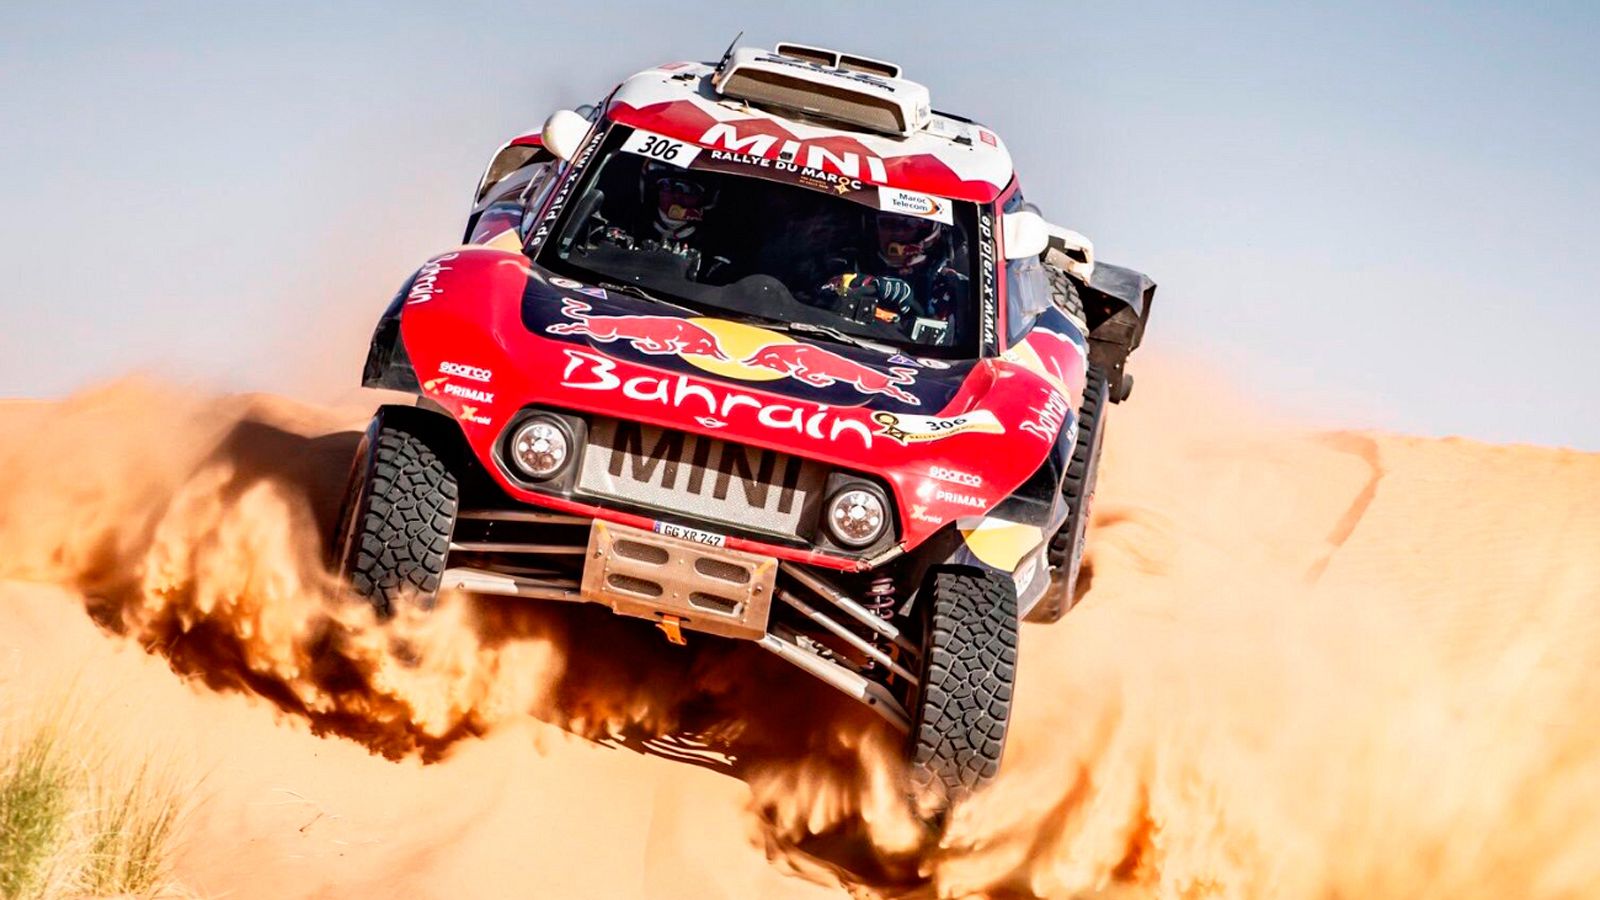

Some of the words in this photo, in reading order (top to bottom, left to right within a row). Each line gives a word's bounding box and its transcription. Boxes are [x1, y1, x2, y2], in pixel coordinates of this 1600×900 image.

[637, 135, 683, 161] 306
[699, 122, 888, 184] MINI
[711, 149, 770, 168] RALLYE
[775, 161, 798, 173] DU
[801, 166, 862, 191] MAROC
[892, 198, 928, 212] Telecom
[899, 192, 927, 205] Maroc
[980, 215, 994, 344] www.x-raid.de
[438, 361, 492, 382] sparco
[444, 383, 494, 403] PRIMAX
[560, 349, 873, 449] Bahrain
[925, 418, 967, 431] 306
[1019, 388, 1069, 443] Bahrain
[608, 420, 800, 515] MINI
[930, 466, 982, 487] sparco
[936, 491, 986, 508] PRIMAX
[664, 525, 680, 538] GG
[681, 529, 697, 542] XR
